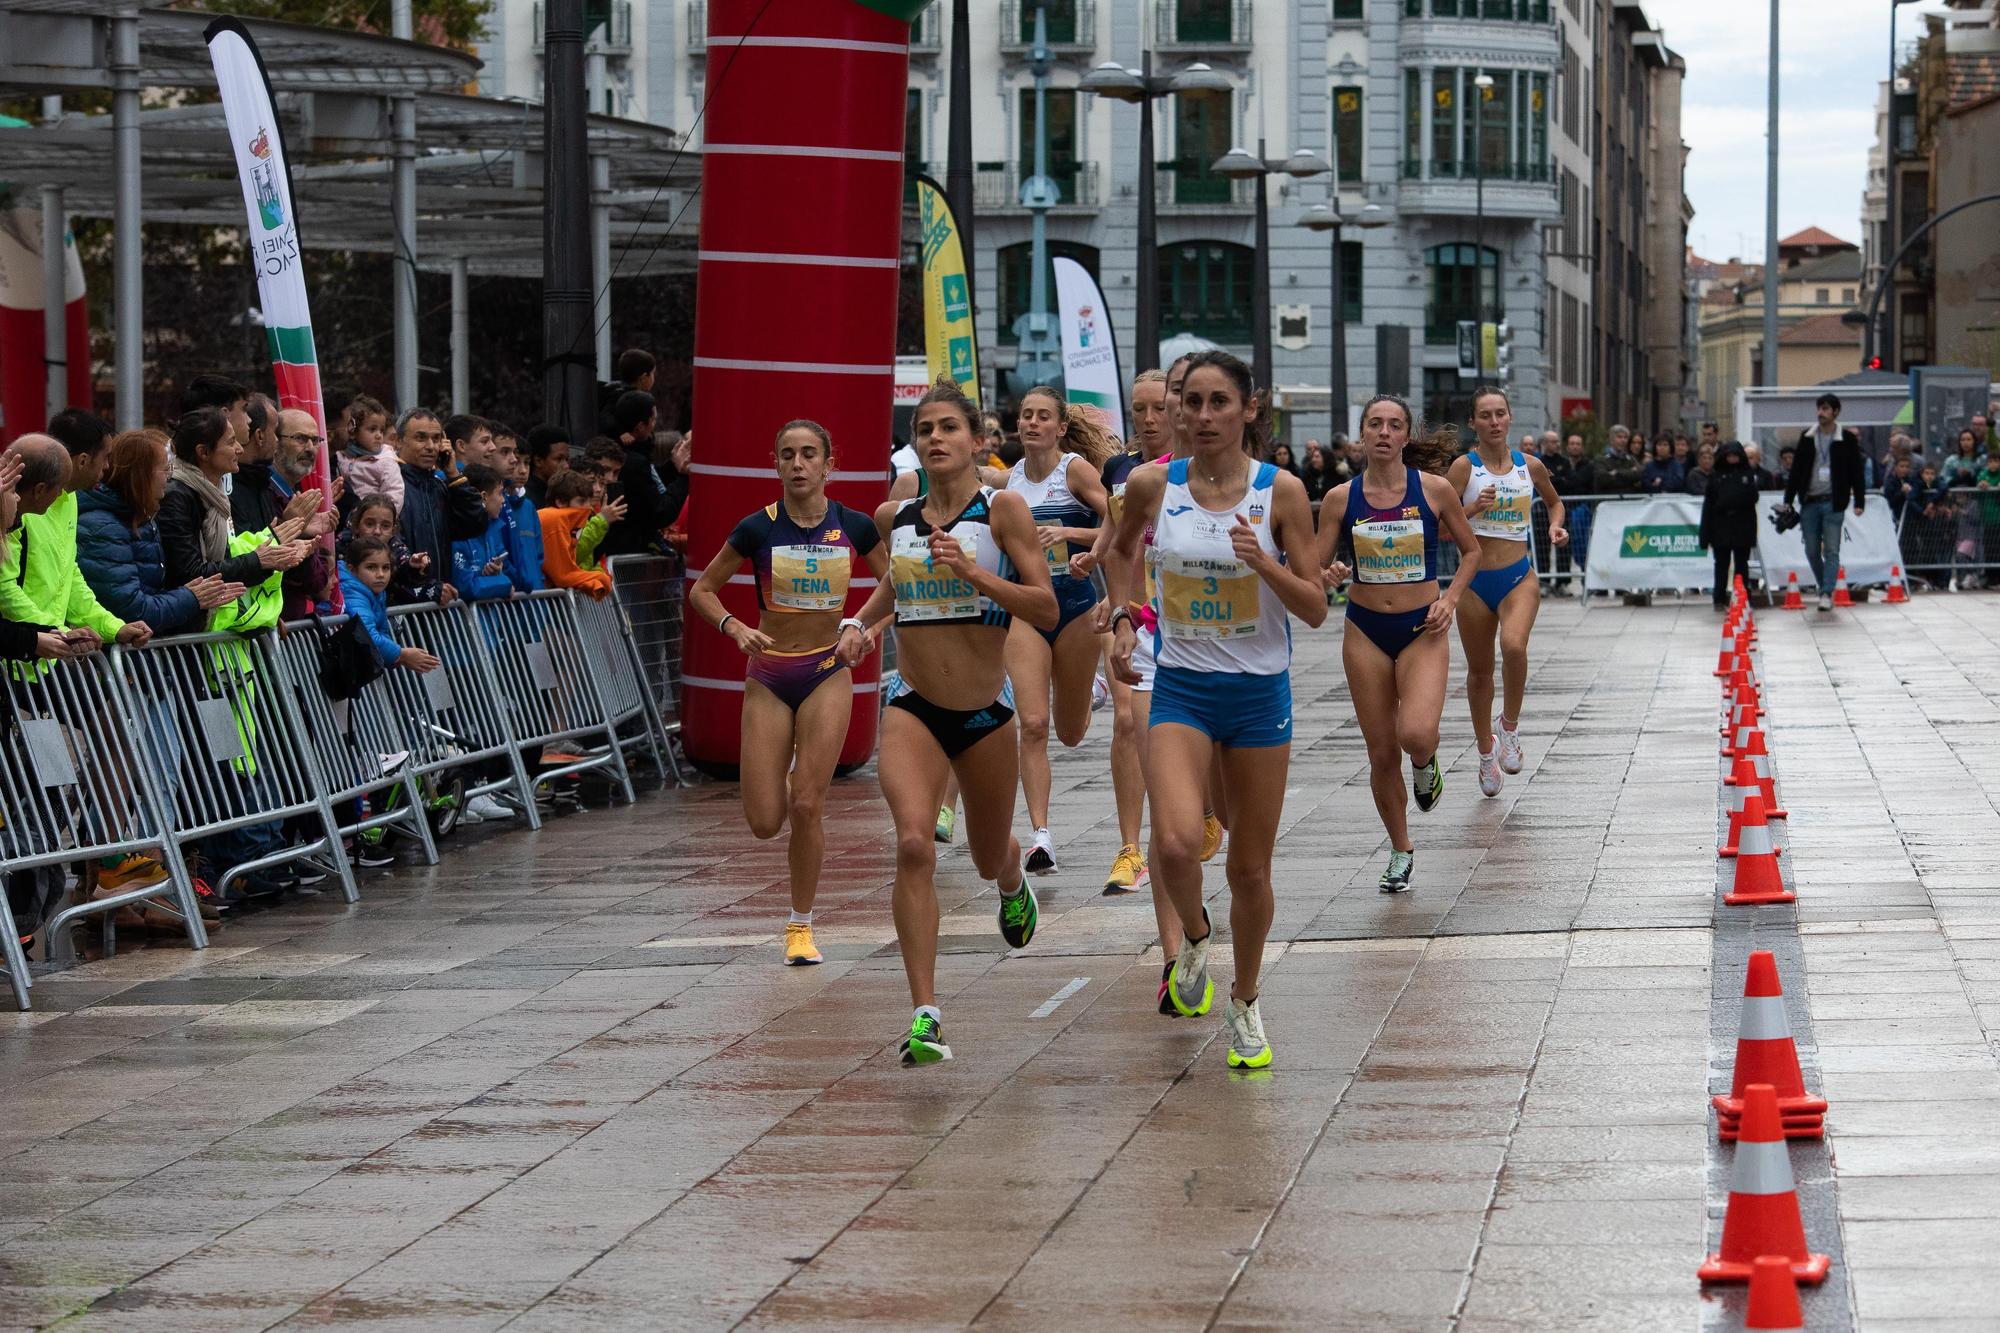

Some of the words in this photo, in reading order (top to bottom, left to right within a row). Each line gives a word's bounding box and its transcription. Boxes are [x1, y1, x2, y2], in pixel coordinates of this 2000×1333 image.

[1497, 496, 1513, 508] 11
[1482, 510, 1524, 522] ANDREA
[1382, 536, 1395, 550] 4
[1674, 534, 1700, 546] RURA
[805, 558, 818, 574] 5
[1358, 553, 1422, 569] PINACCHIO
[791, 578, 831, 594] TENA
[895, 579, 975, 602] MARQUES
[1203, 576, 1218, 595] 3
[1190, 600, 1232, 620] SOLI
[964, 718, 999, 730] adidas
